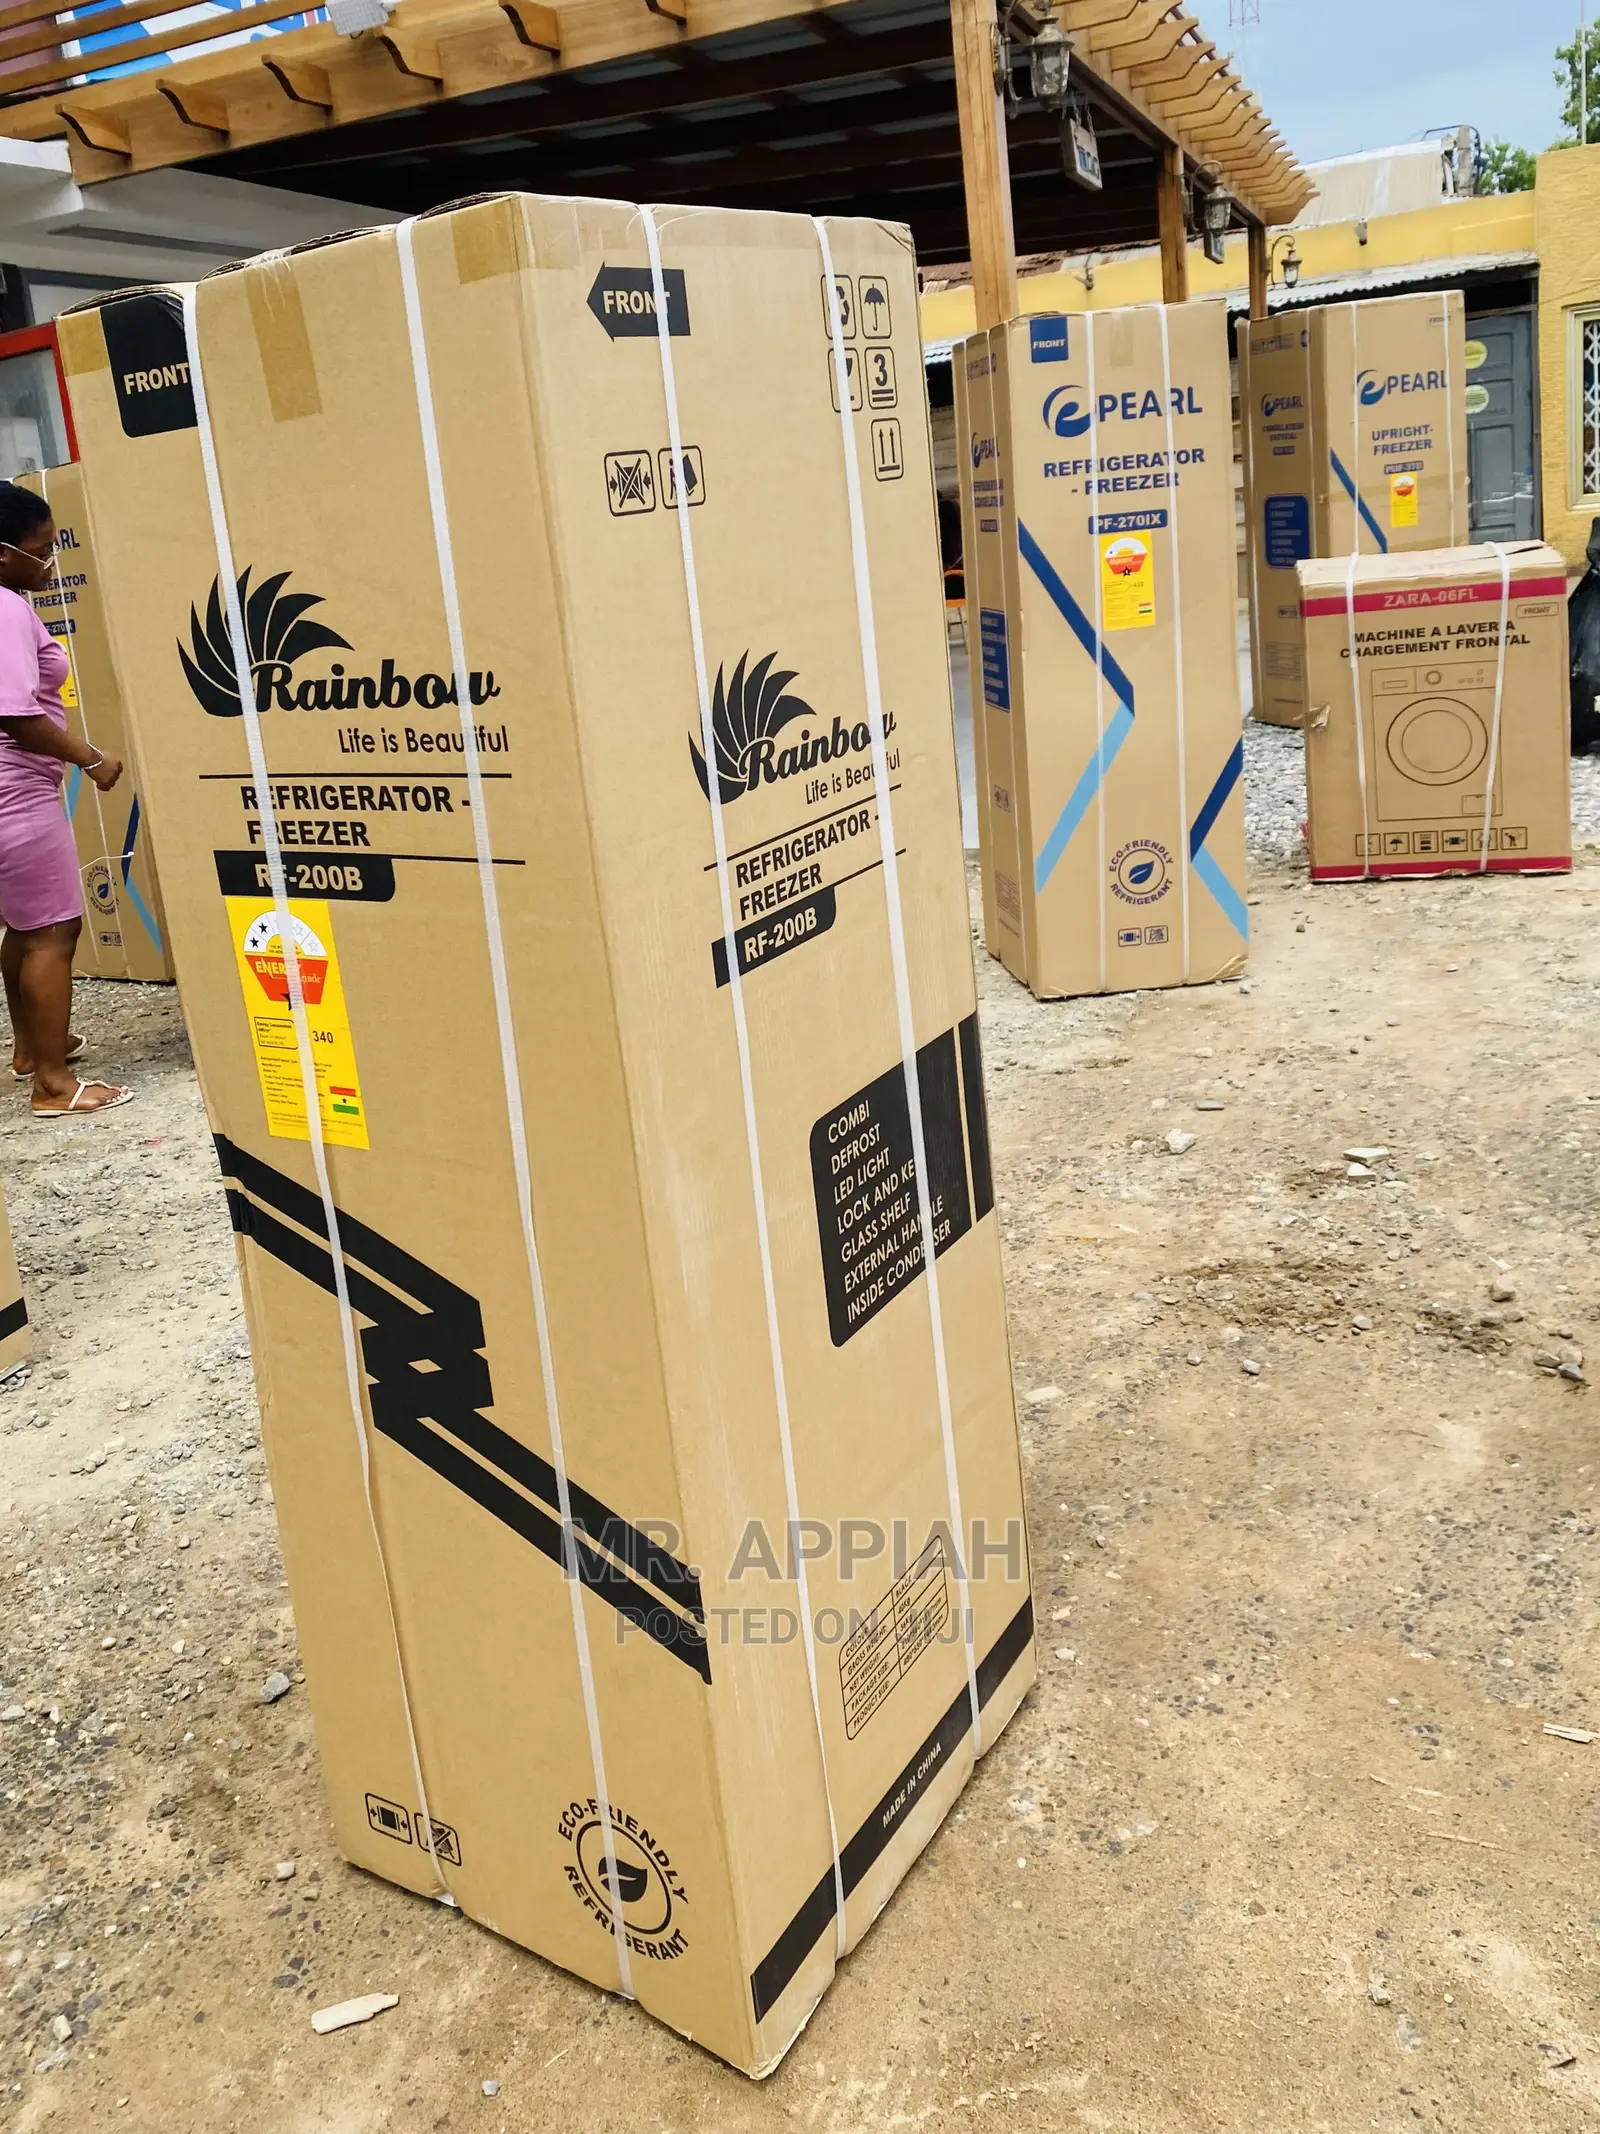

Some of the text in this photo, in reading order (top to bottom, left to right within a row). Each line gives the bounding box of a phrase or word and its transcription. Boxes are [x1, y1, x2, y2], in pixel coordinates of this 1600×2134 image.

[602, 290, 671, 314] FRON
[1033, 339, 1066, 349] FRONT
[123, 362, 190, 395] FRONT
[1388, 370, 1448, 395] PEARL
[1098, 386, 1204, 422] PEARL
[1371, 424, 1434, 441] UPRIGHT-
[1373, 438, 1432, 456] FREEZER
[1383, 588, 1479, 608] ZARA-06FL
[1354, 620, 1516, 643] MACHINE A LAVER A
[338, 725, 509, 753] Life is Beauiful
[805, 778, 828, 804] Life
[832, 771, 842, 794] is
[246, 820, 371, 847] FEEZER
[735, 808, 870, 888] REFRIGERATOR
[1109, 839, 1174, 872] ECO-FRIENDLY
[254, 863, 363, 891] R-200B
[739, 863, 822, 921] FREEZER
[1110, 878, 1173, 905] REFRIGERANT
[743, 906, 818, 964] RF-200B
[312, 1030, 334, 1044] 340
[827, 1100, 870, 1145] COMBI
[830, 1123, 881, 1175] DEFROST
[834, 1147, 890, 1205] LED LIGHT
[837, 1157, 915, 1235] LOCK AND KE
[841, 1192, 911, 1264] GLASS SHELF
[844, 1233, 900, 1294] EXTERNAL
[847, 1218, 952, 1323] INSIDE CONDESER
[847, 1650, 866, 1676] GROSS
[849, 1674, 860, 1694] NET
[851, 1677, 877, 1712] PACKAGE
[853, 1693, 878, 1729] PRODUCT
[882, 1742, 942, 1828] MADE IN CHINA
